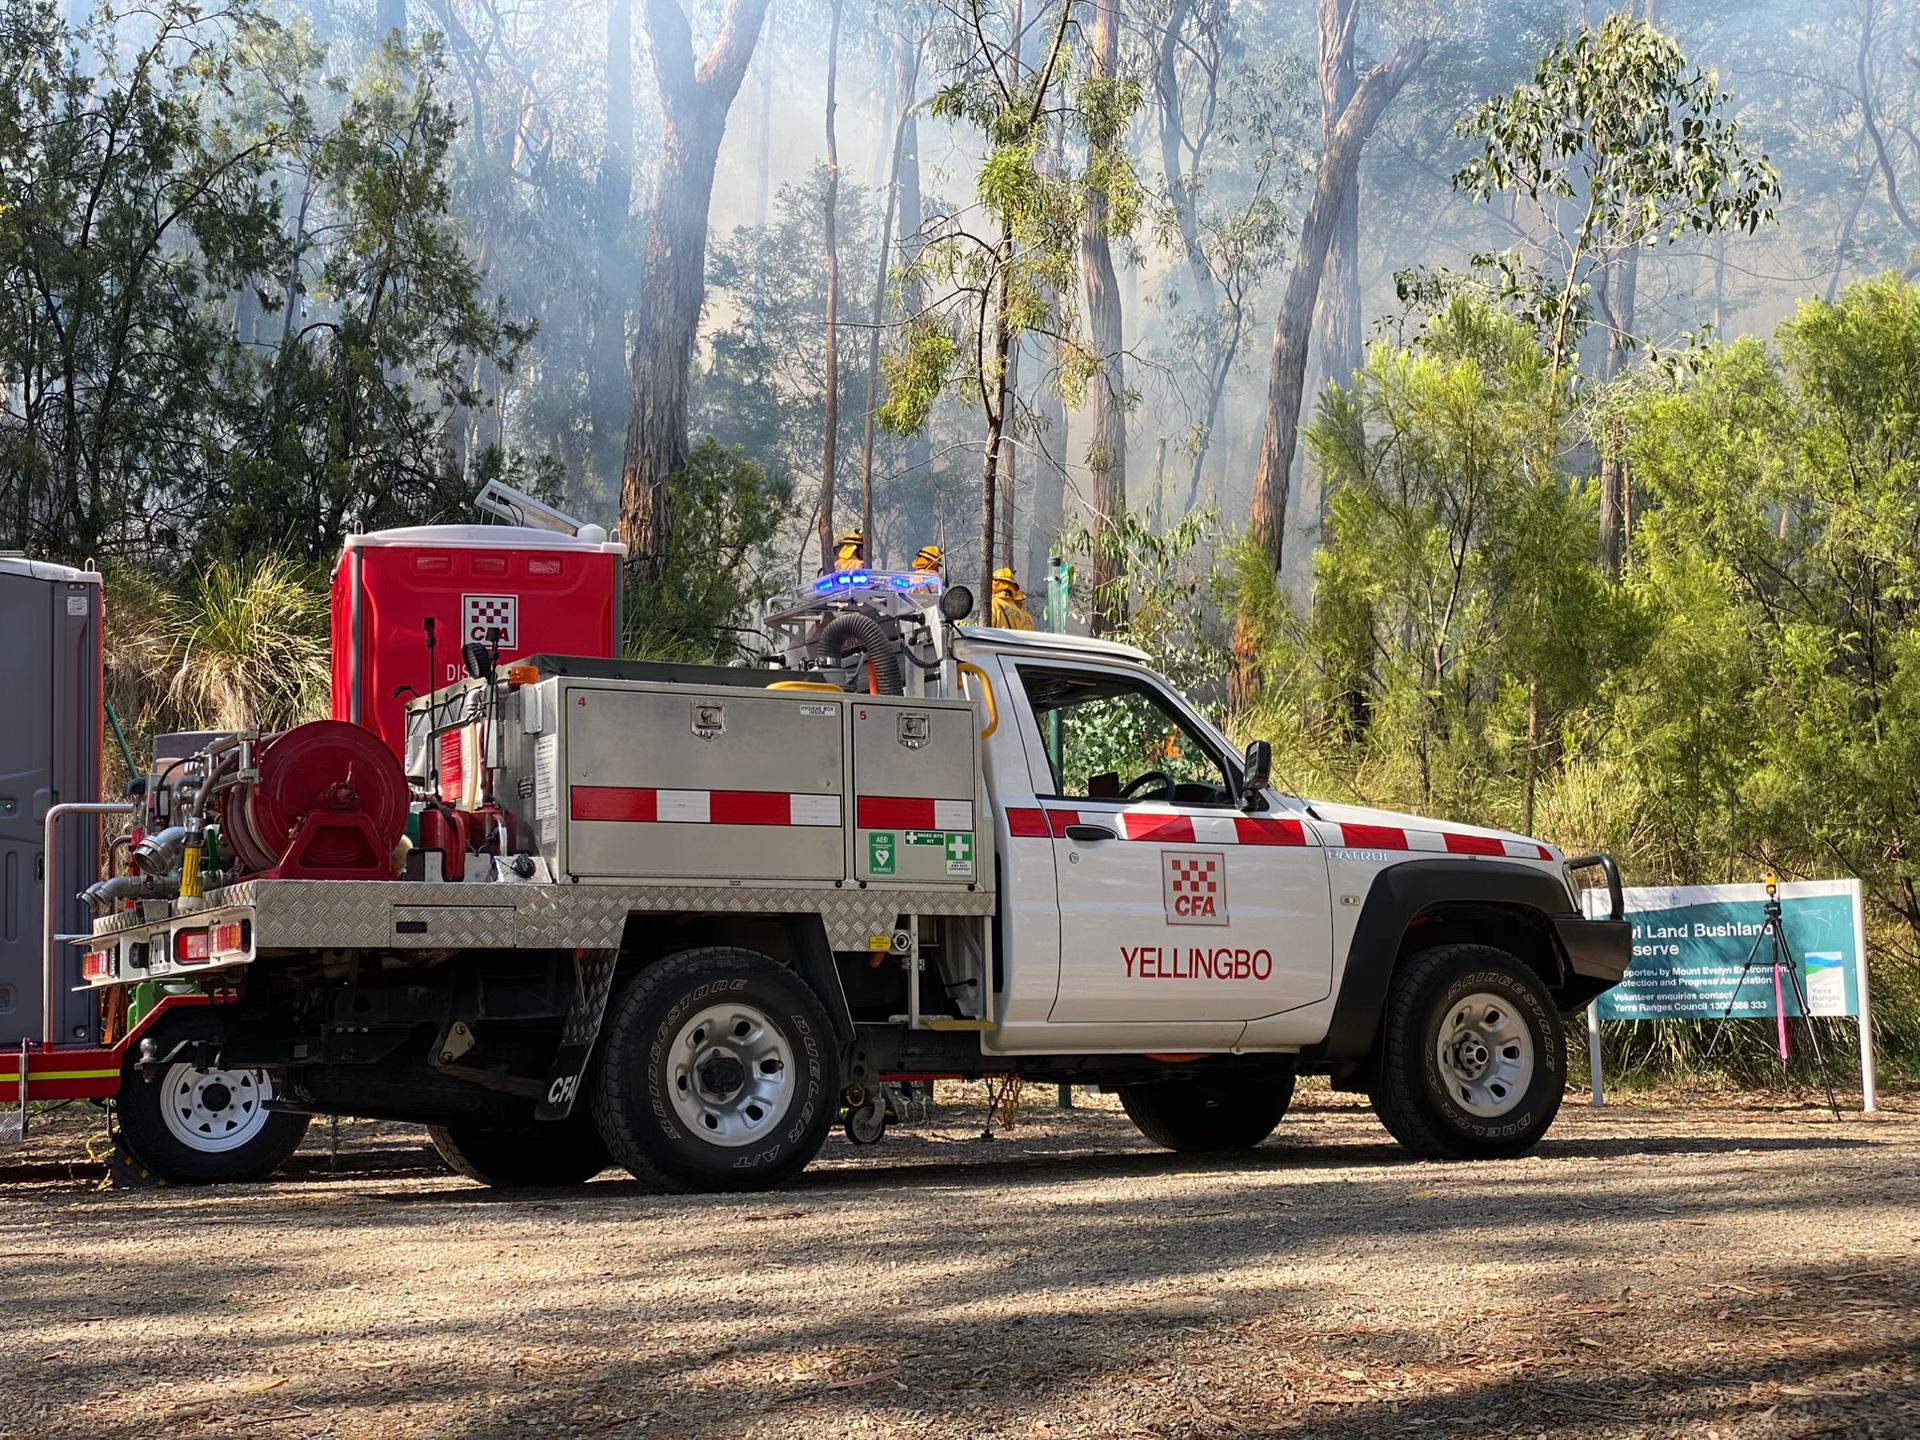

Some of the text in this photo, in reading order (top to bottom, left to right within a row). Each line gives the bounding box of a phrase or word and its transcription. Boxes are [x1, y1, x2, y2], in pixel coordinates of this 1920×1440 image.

[470, 626, 509, 642] CA
[577, 697, 586, 708] 4
[860, 710, 867, 720] 5
[1327, 850, 1392, 862] PATROL
[1174, 895, 1217, 917] CFA
[1646, 924, 1688, 939] Land
[1694, 922, 1774, 938] Bushland
[1632, 943, 1680, 957] serve
[1120, 947, 1273, 981] YELLINGBO
[1659, 968, 1671, 978] by
[1672, 967, 1701, 976] Mount
[1702, 966, 1733, 977] Evelyn
[1618, 977, 1658, 988] rotection
[1660, 977, 1677, 986] and
[1678, 977, 1718, 988] Progress
[1613, 991, 1733, 1003] Volunteer enquiries contact
[1614, 1003, 1637, 1013] Yarra
[1639, 1003, 1672, 1013] Ranges
[1674, 1002, 1708, 1011] Council
[1710, 1002, 1729, 1011] 1300
[1750, 1001, 1767, 1010] 333
[1447, 972, 1556, 1073] BRIDGESTONE
[648, 979, 748, 1140] BRIDGESTONE
[548, 1075, 577, 1104] CFA
[732, 1014, 822, 1168] DUELER A/T
